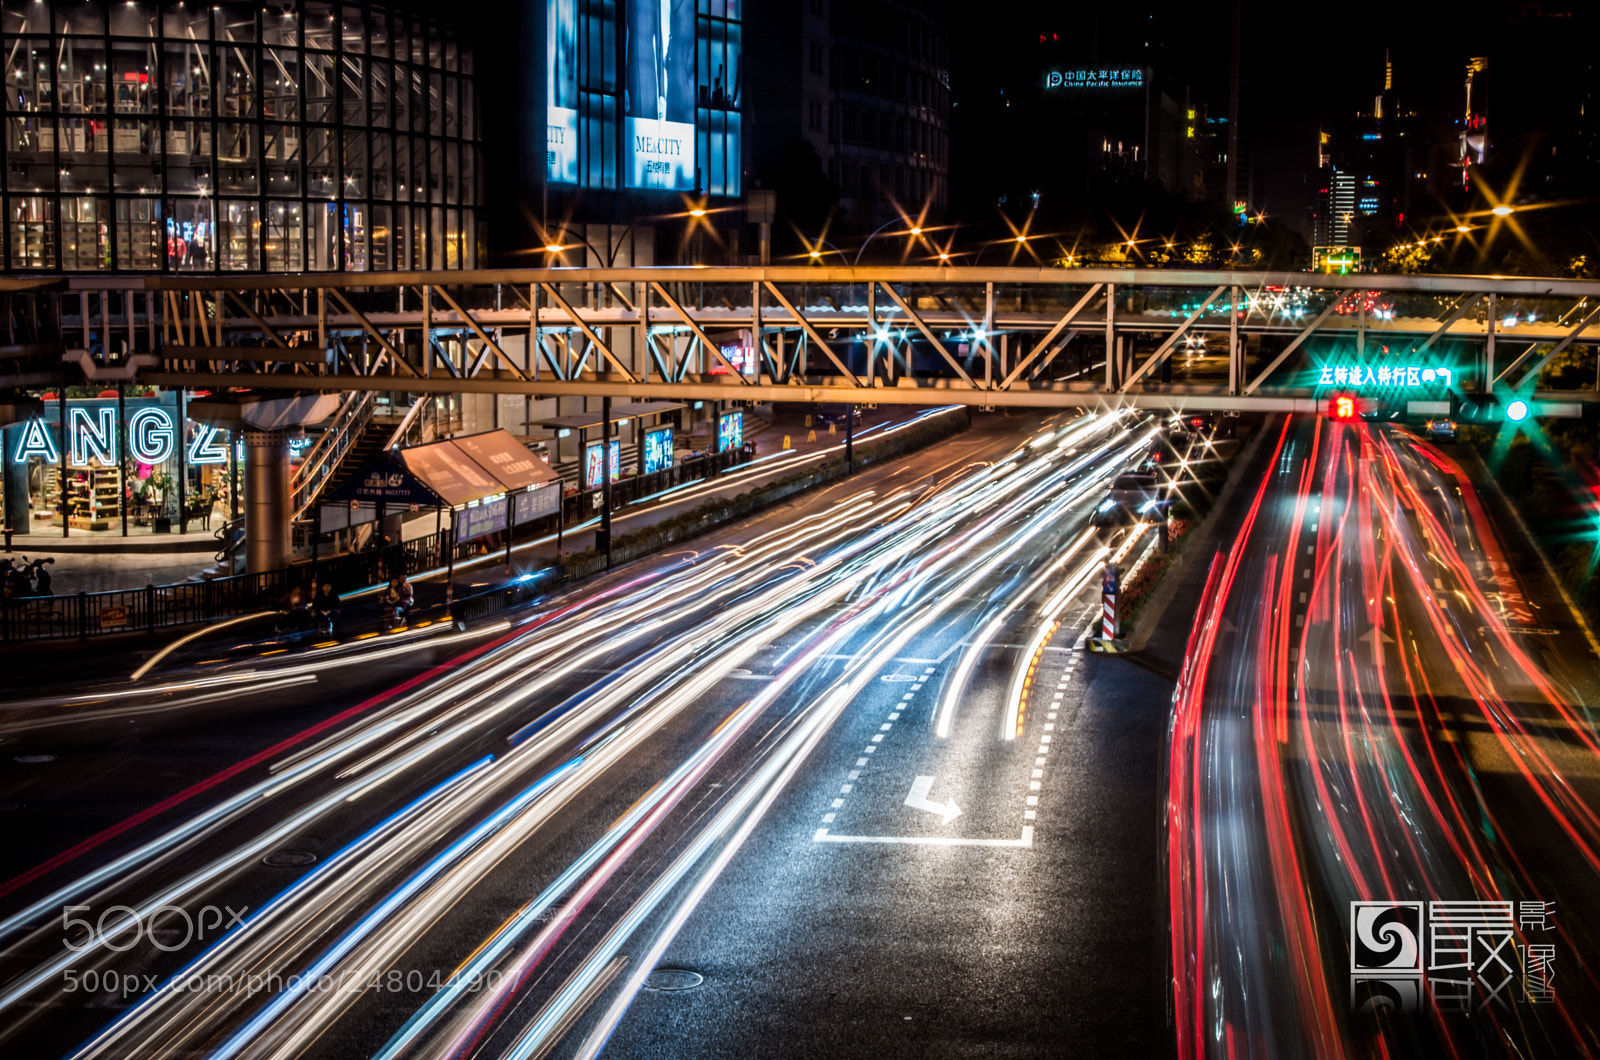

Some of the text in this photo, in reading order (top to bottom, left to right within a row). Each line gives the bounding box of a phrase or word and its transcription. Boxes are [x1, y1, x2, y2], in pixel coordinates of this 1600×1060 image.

[1064, 70, 1143, 81] 中国太平洋保险
[547, 125, 566, 144] ITY
[1318, 364, 1421, 386] 左转进入待行区
[15, 407, 245, 467] ANGZ
